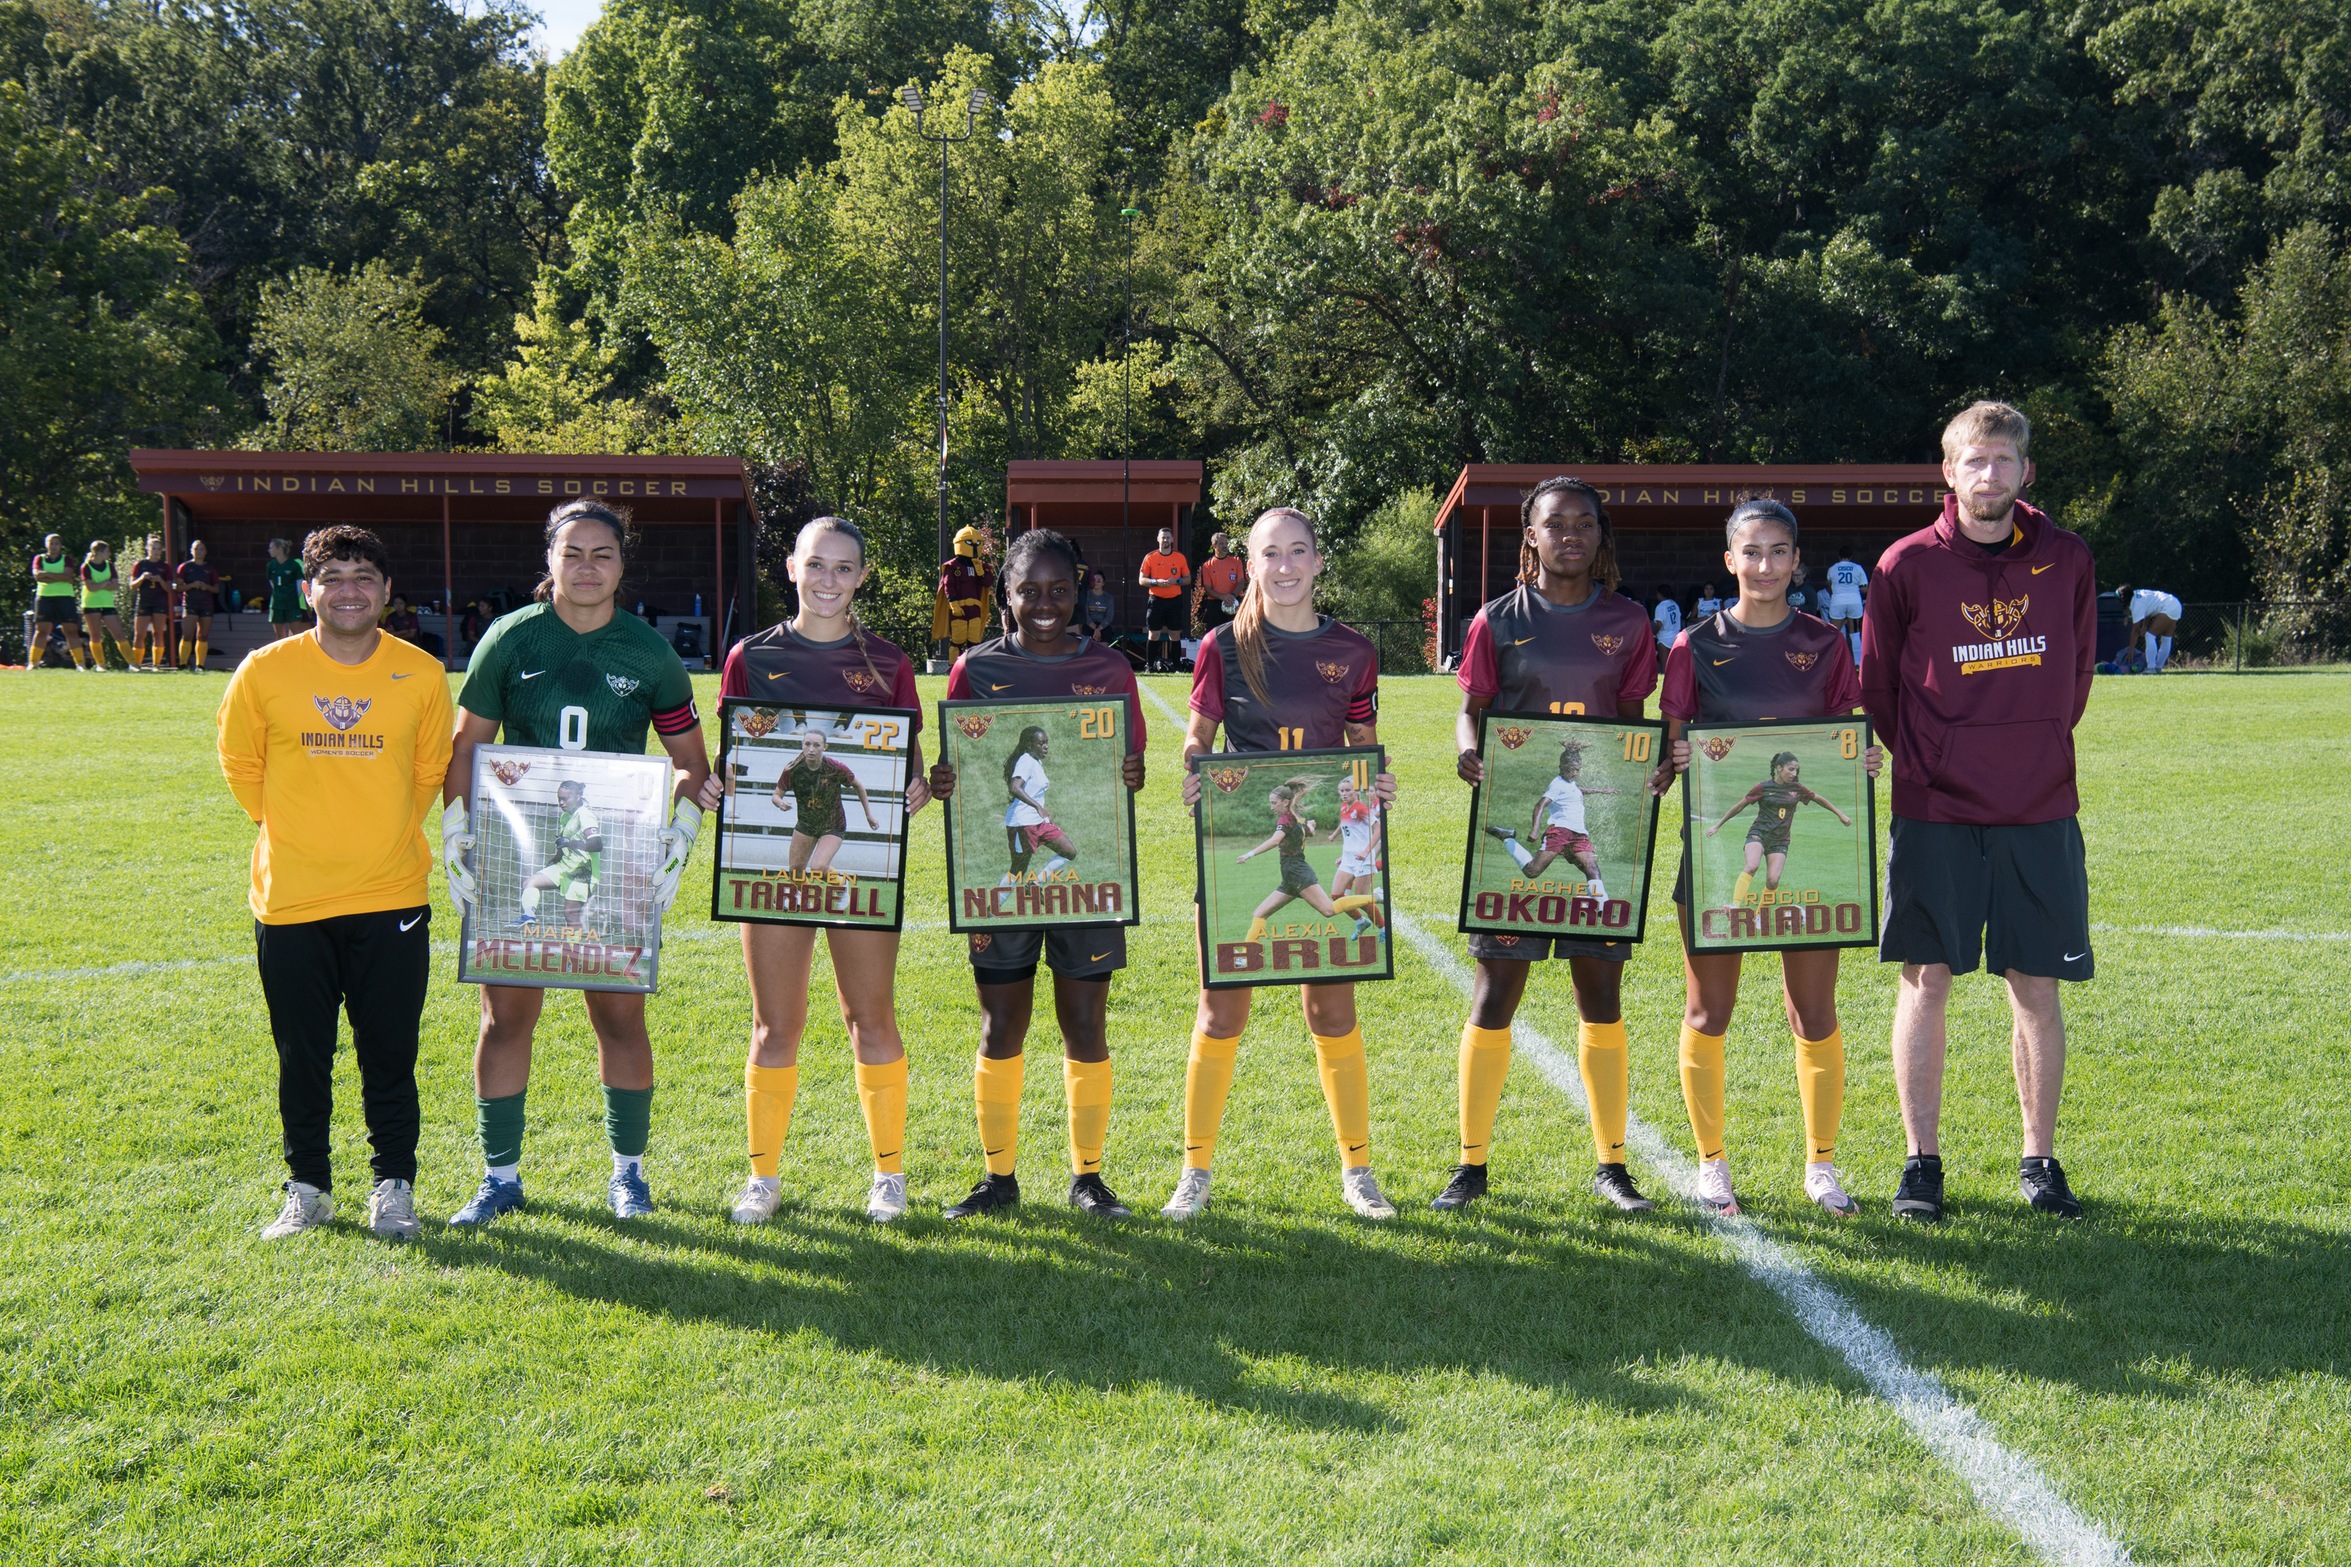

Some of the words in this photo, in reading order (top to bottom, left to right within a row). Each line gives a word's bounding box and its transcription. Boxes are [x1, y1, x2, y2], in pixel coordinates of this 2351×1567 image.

[237, 477, 375, 493] INDIAN
[401, 479, 511, 494] HILLS
[537, 480, 687, 496] SOCCER
[1599, 490, 1679, 504] DIAN
[1703, 490, 1806, 504] HIS
[1831, 490, 1947, 504] SOCCE
[1838, 572, 1853, 584] 20
[1952, 641, 2004, 663] INDIAN
[2006, 635, 2047, 656] HILLS
[1968, 656, 2036, 670] WARRIORS
[559, 705, 589, 751] 0
[853, 720, 900, 752] #22
[1068, 707, 1115, 739] #20
[301, 732, 345, 748] INDIAN
[348, 734, 384, 749] HILLS
[1616, 731, 1651, 763] #10
[1830, 728, 1858, 760] #8
[1341, 759, 1368, 791] #11
[762, 867, 858, 885] LAUREN
[1007, 868, 1081, 885] MAIKA
[1510, 879, 1604, 898] RACHEL
[728, 879, 887, 919] TARBELL
[962, 881, 1123, 920] NCHANA
[1474, 890, 1632, 929] OKORO
[1744, 889, 1820, 906] ROCIO
[522, 924, 600, 942] MARIA
[1255, 921, 1340, 940] ALEXIA
[1701, 902, 1862, 941] CRIADO
[474, 936, 645, 978] MELENDEZ
[1215, 935, 1379, 975] BRU
